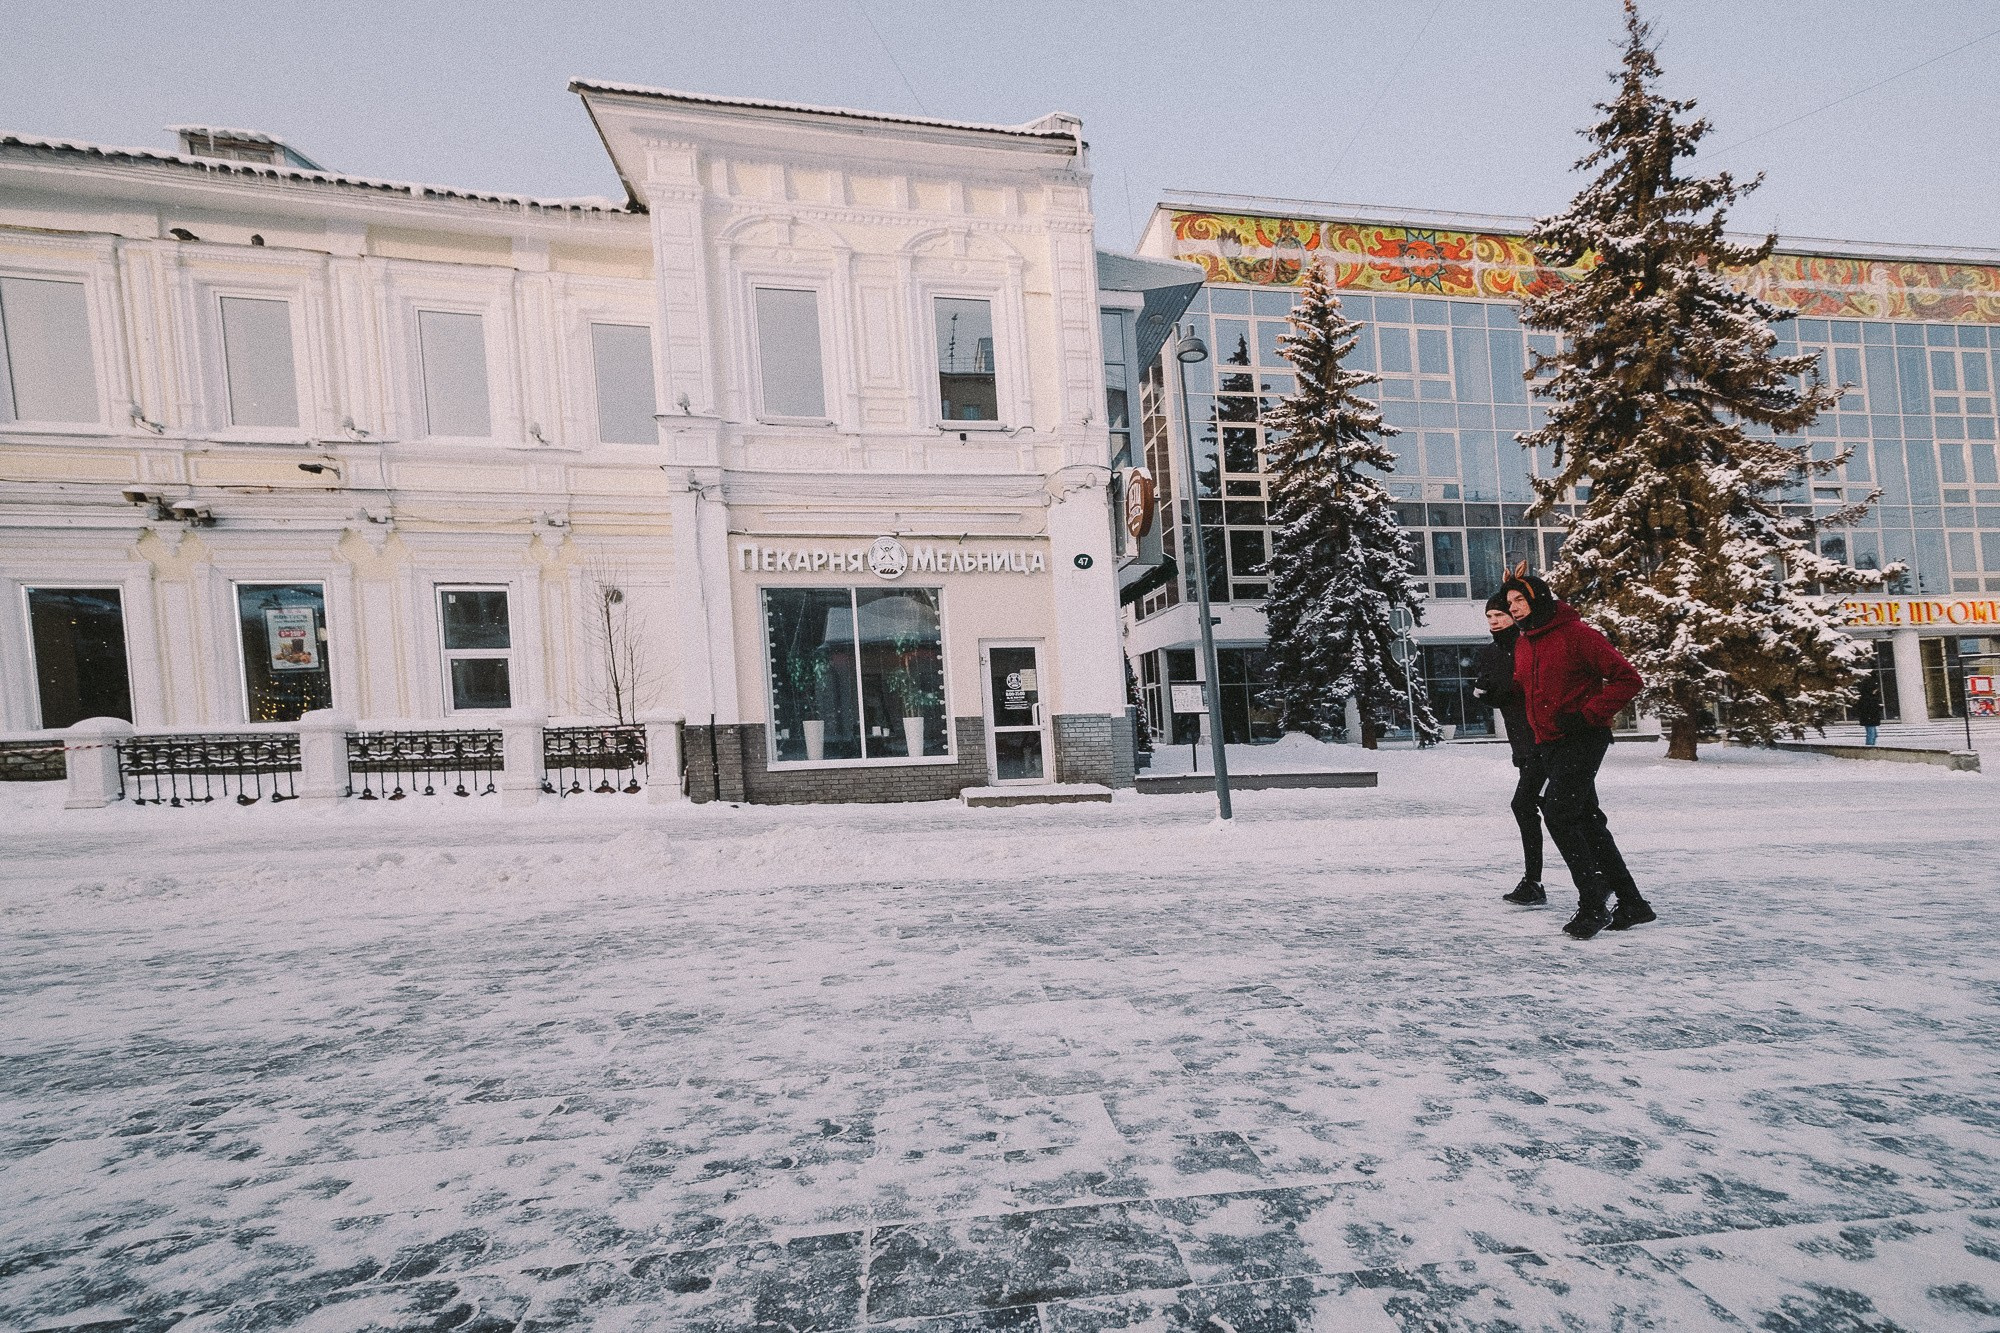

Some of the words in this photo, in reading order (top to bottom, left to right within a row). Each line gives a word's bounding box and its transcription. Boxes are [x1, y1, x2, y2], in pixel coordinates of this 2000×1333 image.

[737, 544, 864, 571] ПЕКАРНЯ
[912, 545, 1046, 575] МЕЛЬНИЦА
[1077, 557, 1089, 566] 47
